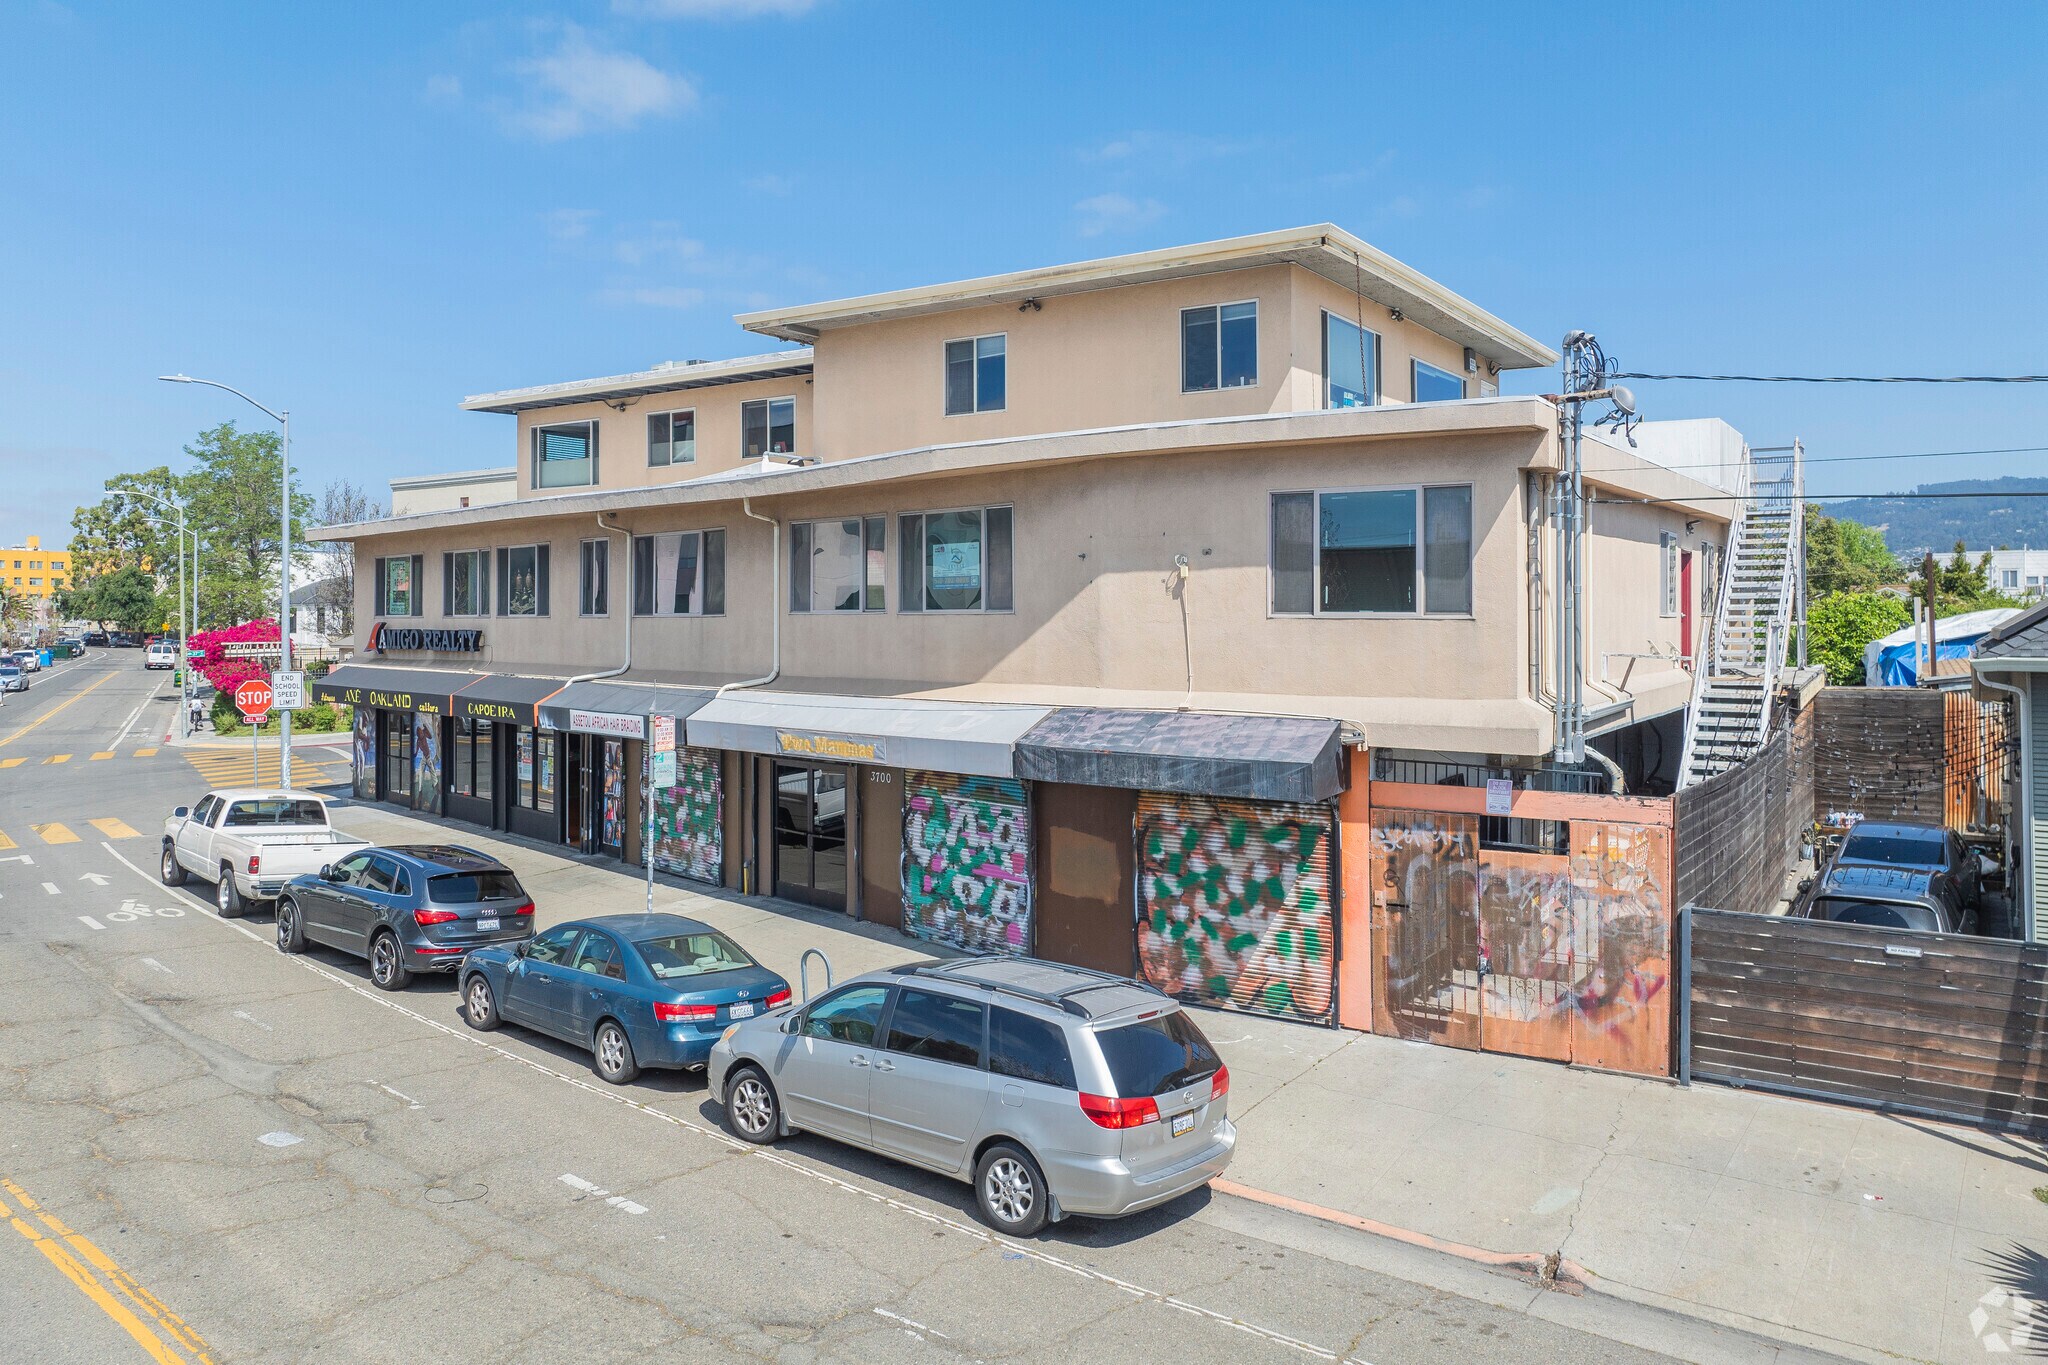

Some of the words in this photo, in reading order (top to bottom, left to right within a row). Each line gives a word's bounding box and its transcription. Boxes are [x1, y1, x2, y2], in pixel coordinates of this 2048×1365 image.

[379, 629, 419, 650] AMIGO
[423, 630, 477, 652] REALTY
[238, 691, 272, 705] STOP
[369, 691, 412, 709] OAKLAND
[467, 702, 516, 720] CAPOEIRA
[591, 715, 609, 730] AFRICAN
[610, 717, 620, 731] HAIR
[621, 718, 642, 733] BRAIDING
[814, 736, 875, 761] Mammas
[870, 771, 892, 784] 3700
